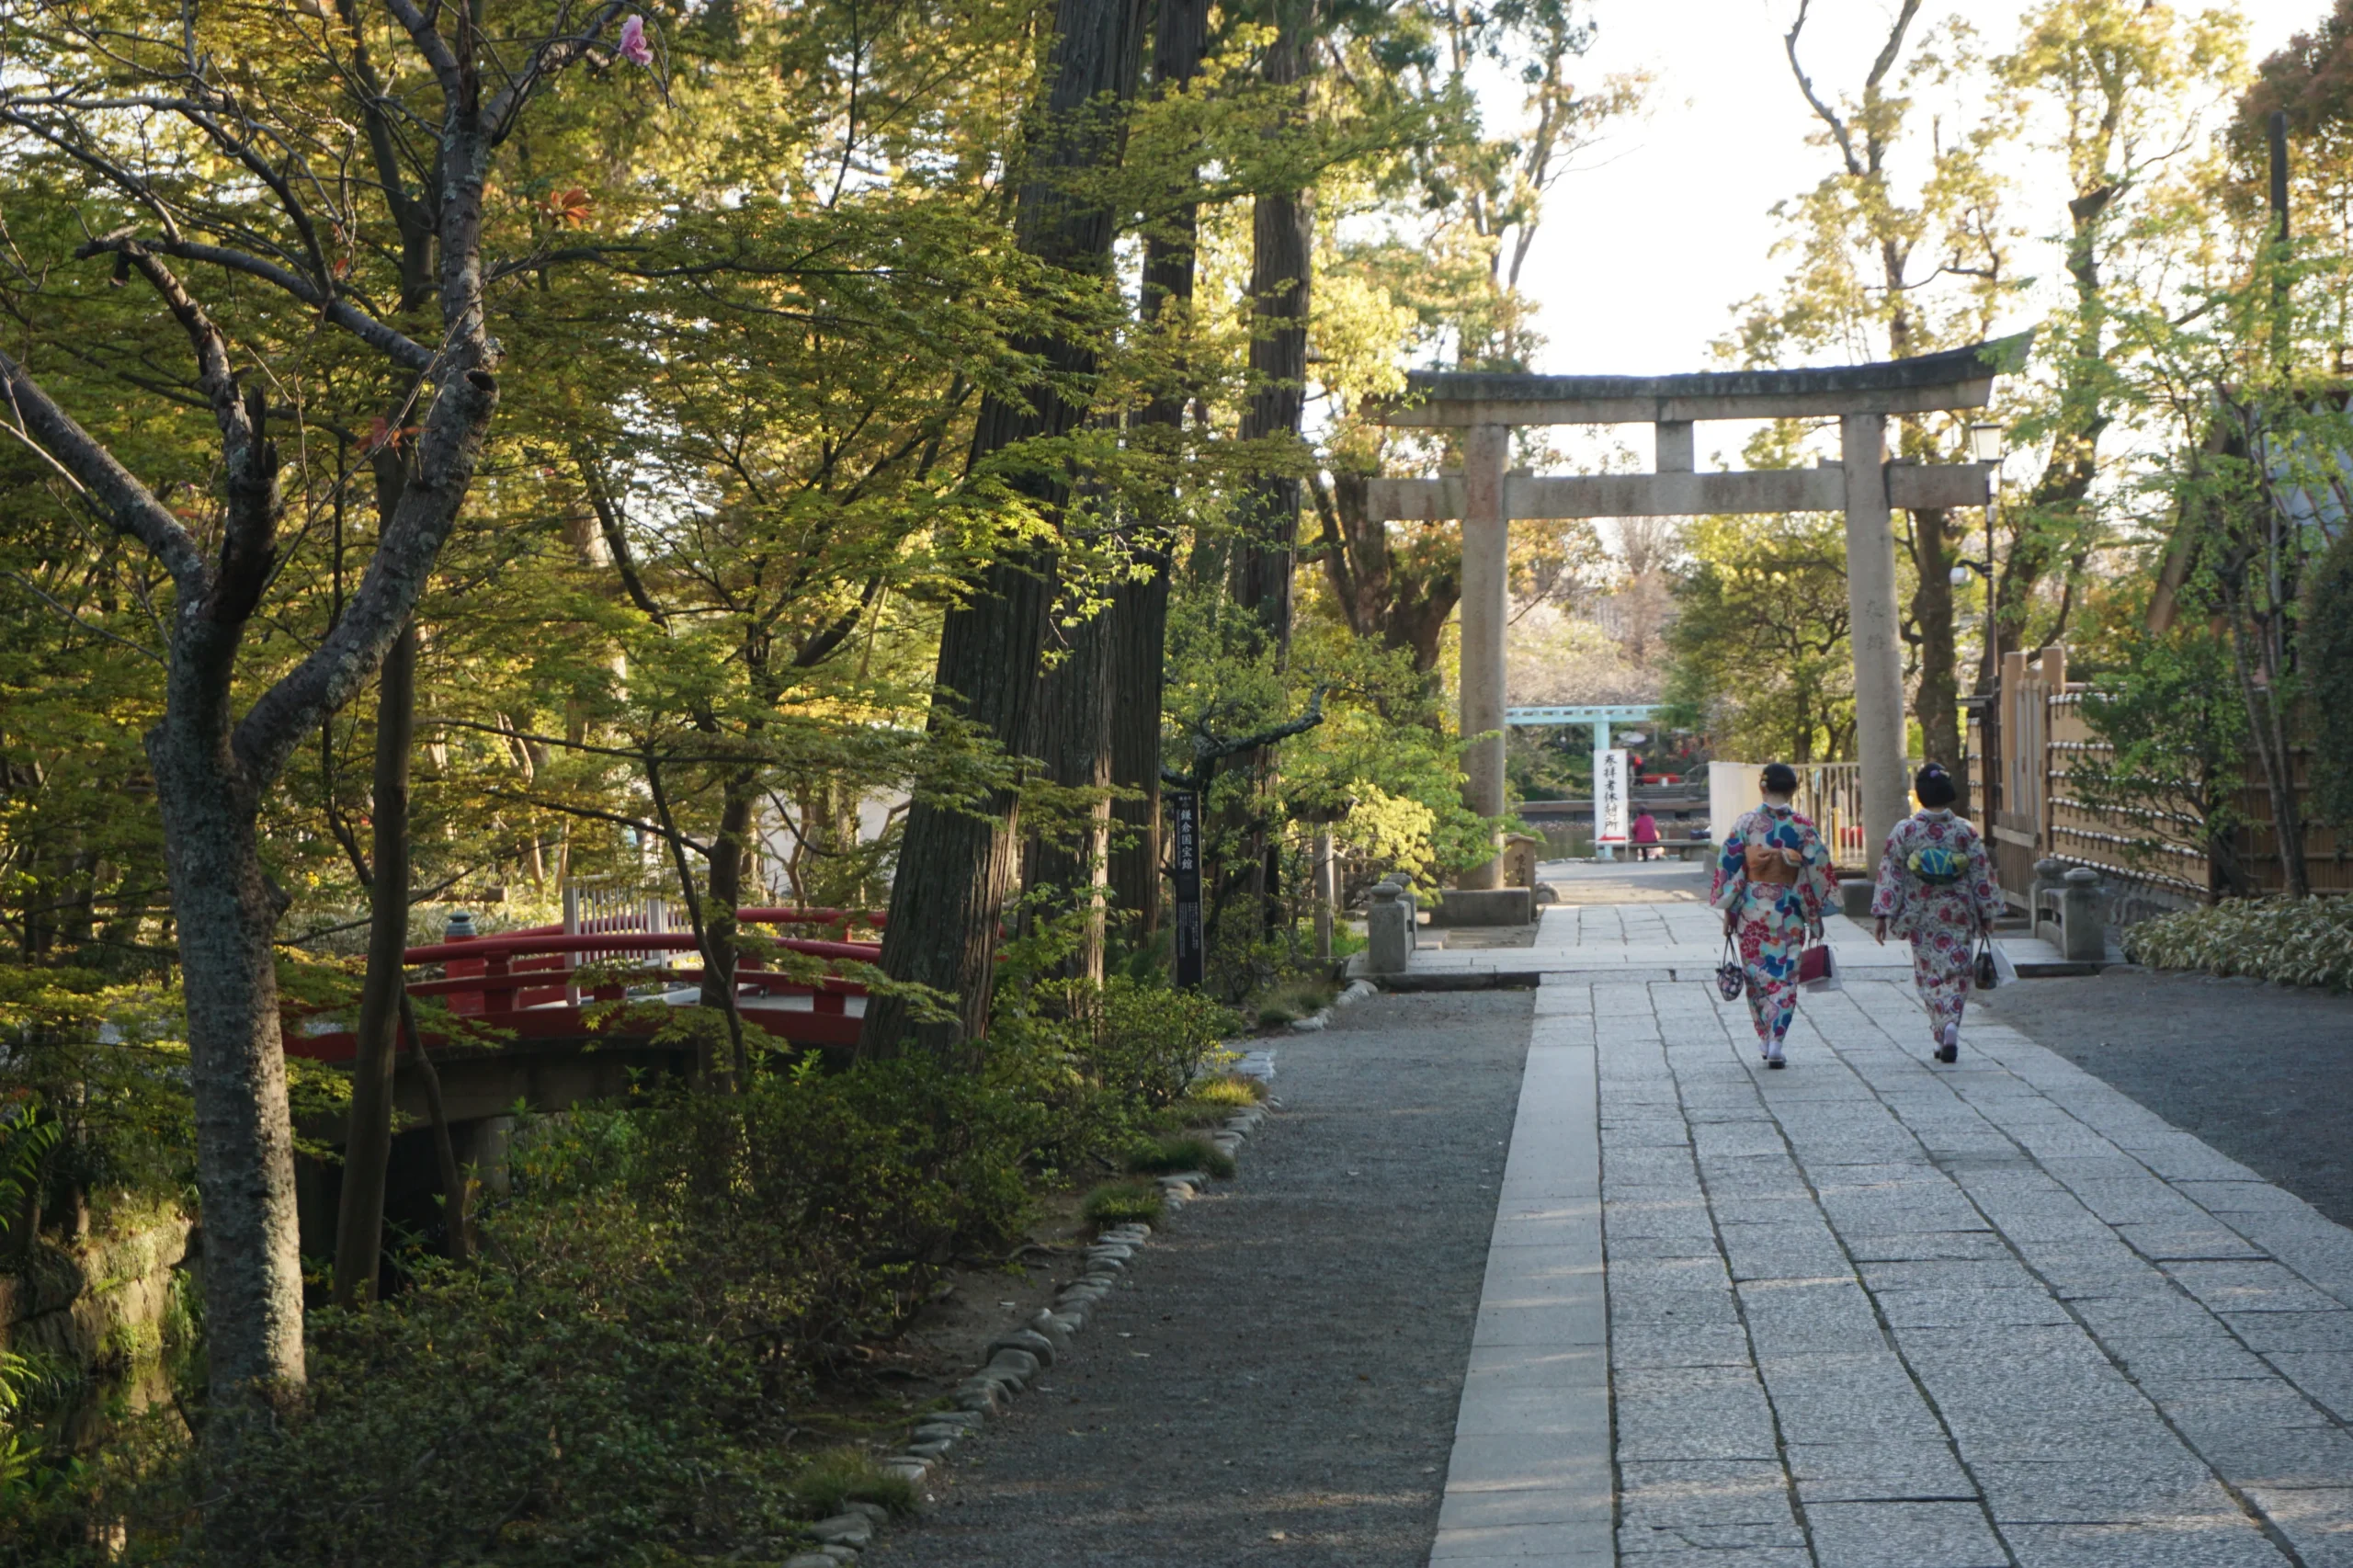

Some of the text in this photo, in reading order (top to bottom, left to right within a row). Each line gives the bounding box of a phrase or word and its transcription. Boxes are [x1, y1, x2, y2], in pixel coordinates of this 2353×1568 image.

[1603, 754, 1619, 832] 参拝者休憩所
[1180, 809, 1193, 870] 鎌倉国宝館
